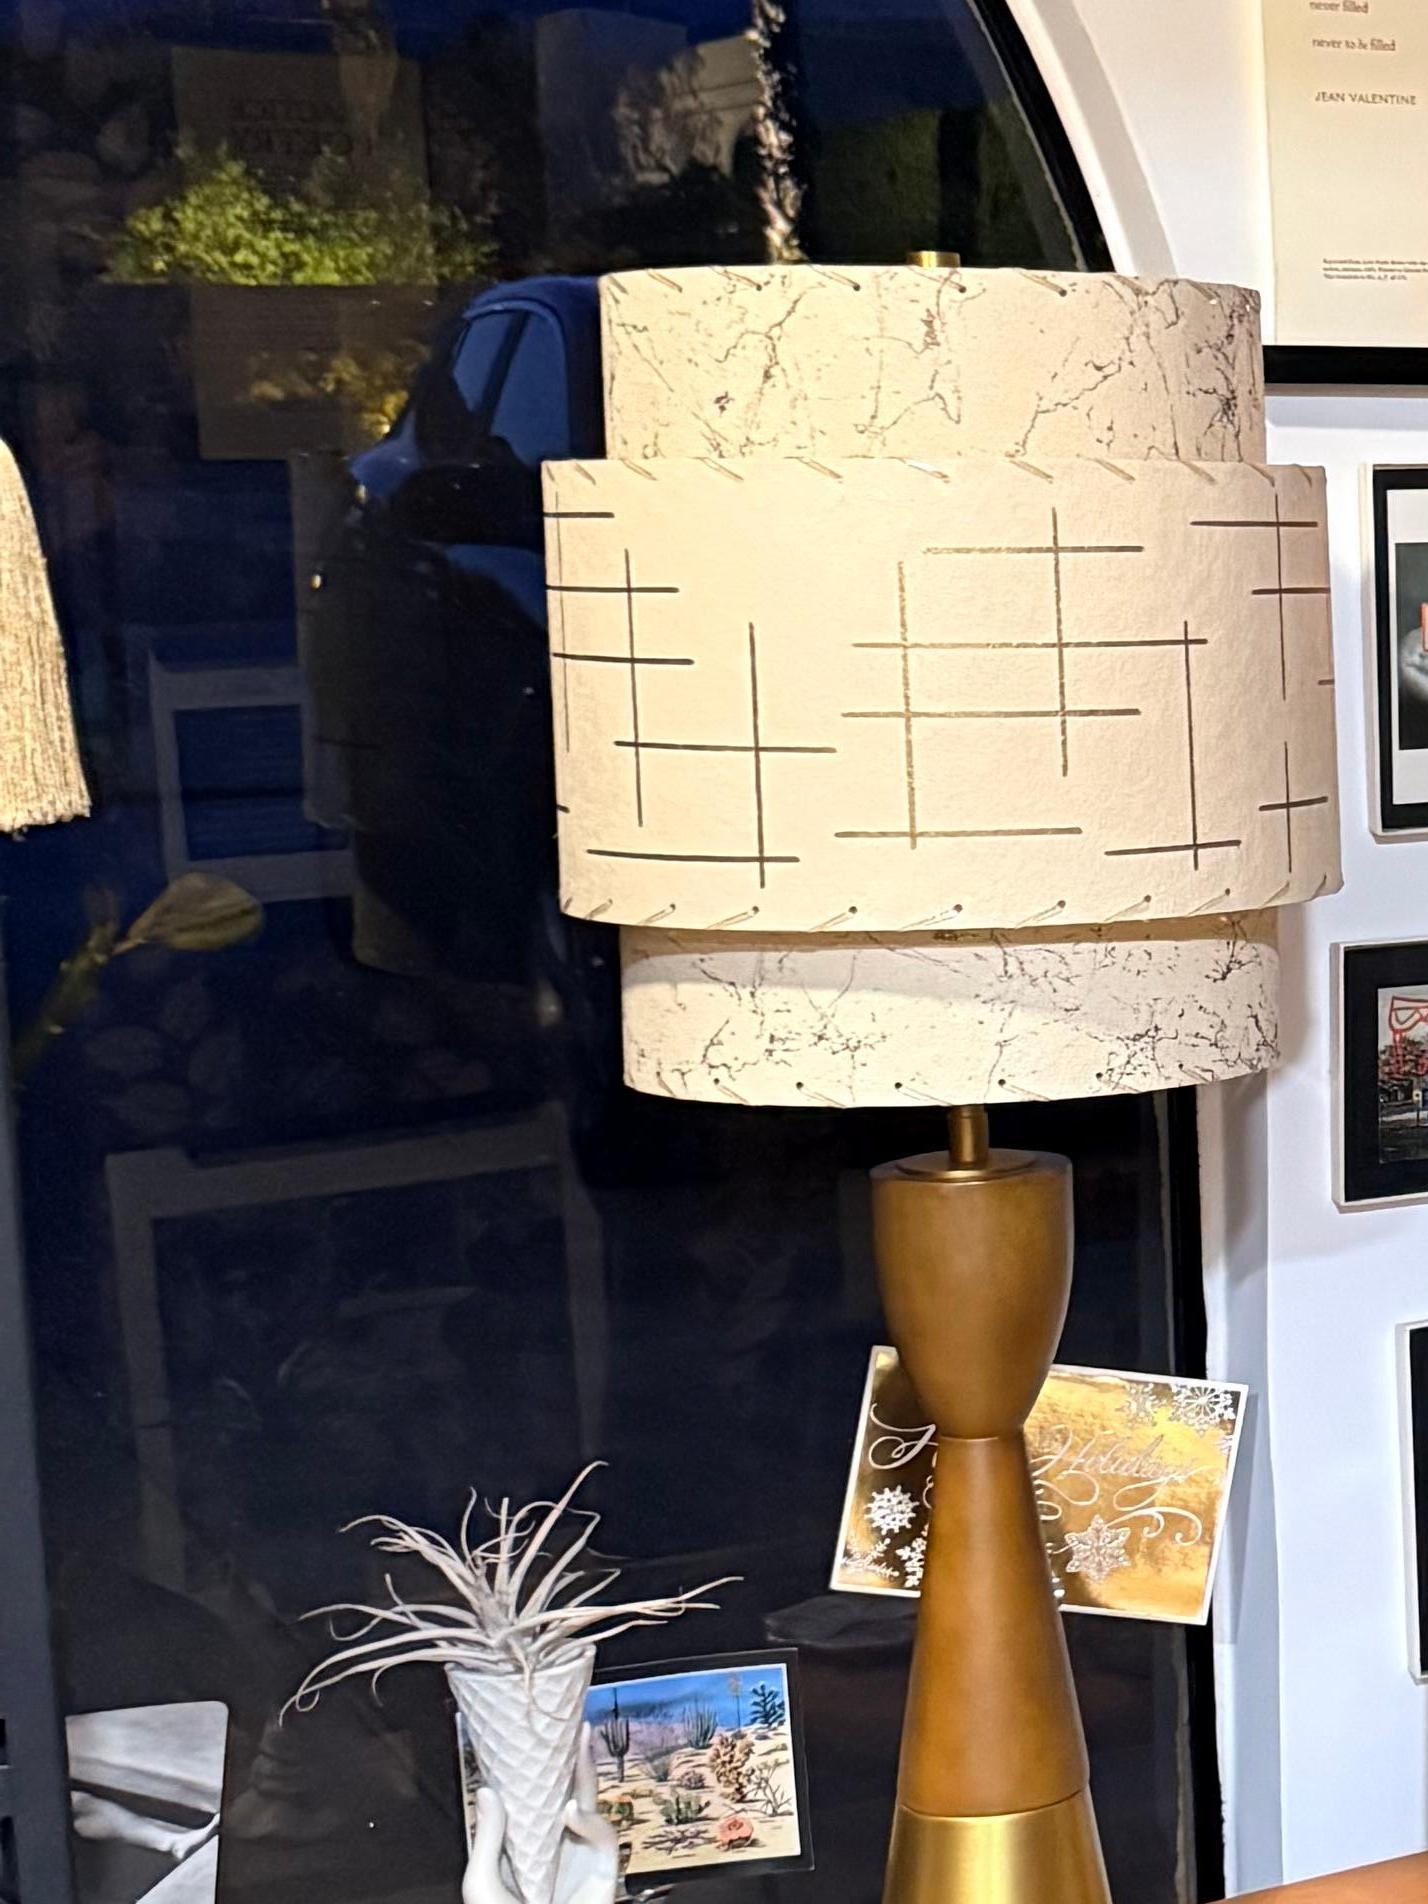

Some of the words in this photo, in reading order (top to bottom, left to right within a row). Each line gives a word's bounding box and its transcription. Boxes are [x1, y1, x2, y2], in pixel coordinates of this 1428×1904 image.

[1309, 1, 1340, 11] never
[1342, 0, 1368, 14] filled
[1312, 38, 1342, 49] never
[1345, 40, 1354, 49] to
[1358, 38, 1368, 50] be
[1370, 38, 1396, 51] filled
[1315, 92, 1345, 102] JEAN
[1349, 93, 1416, 105] VALENTINE
